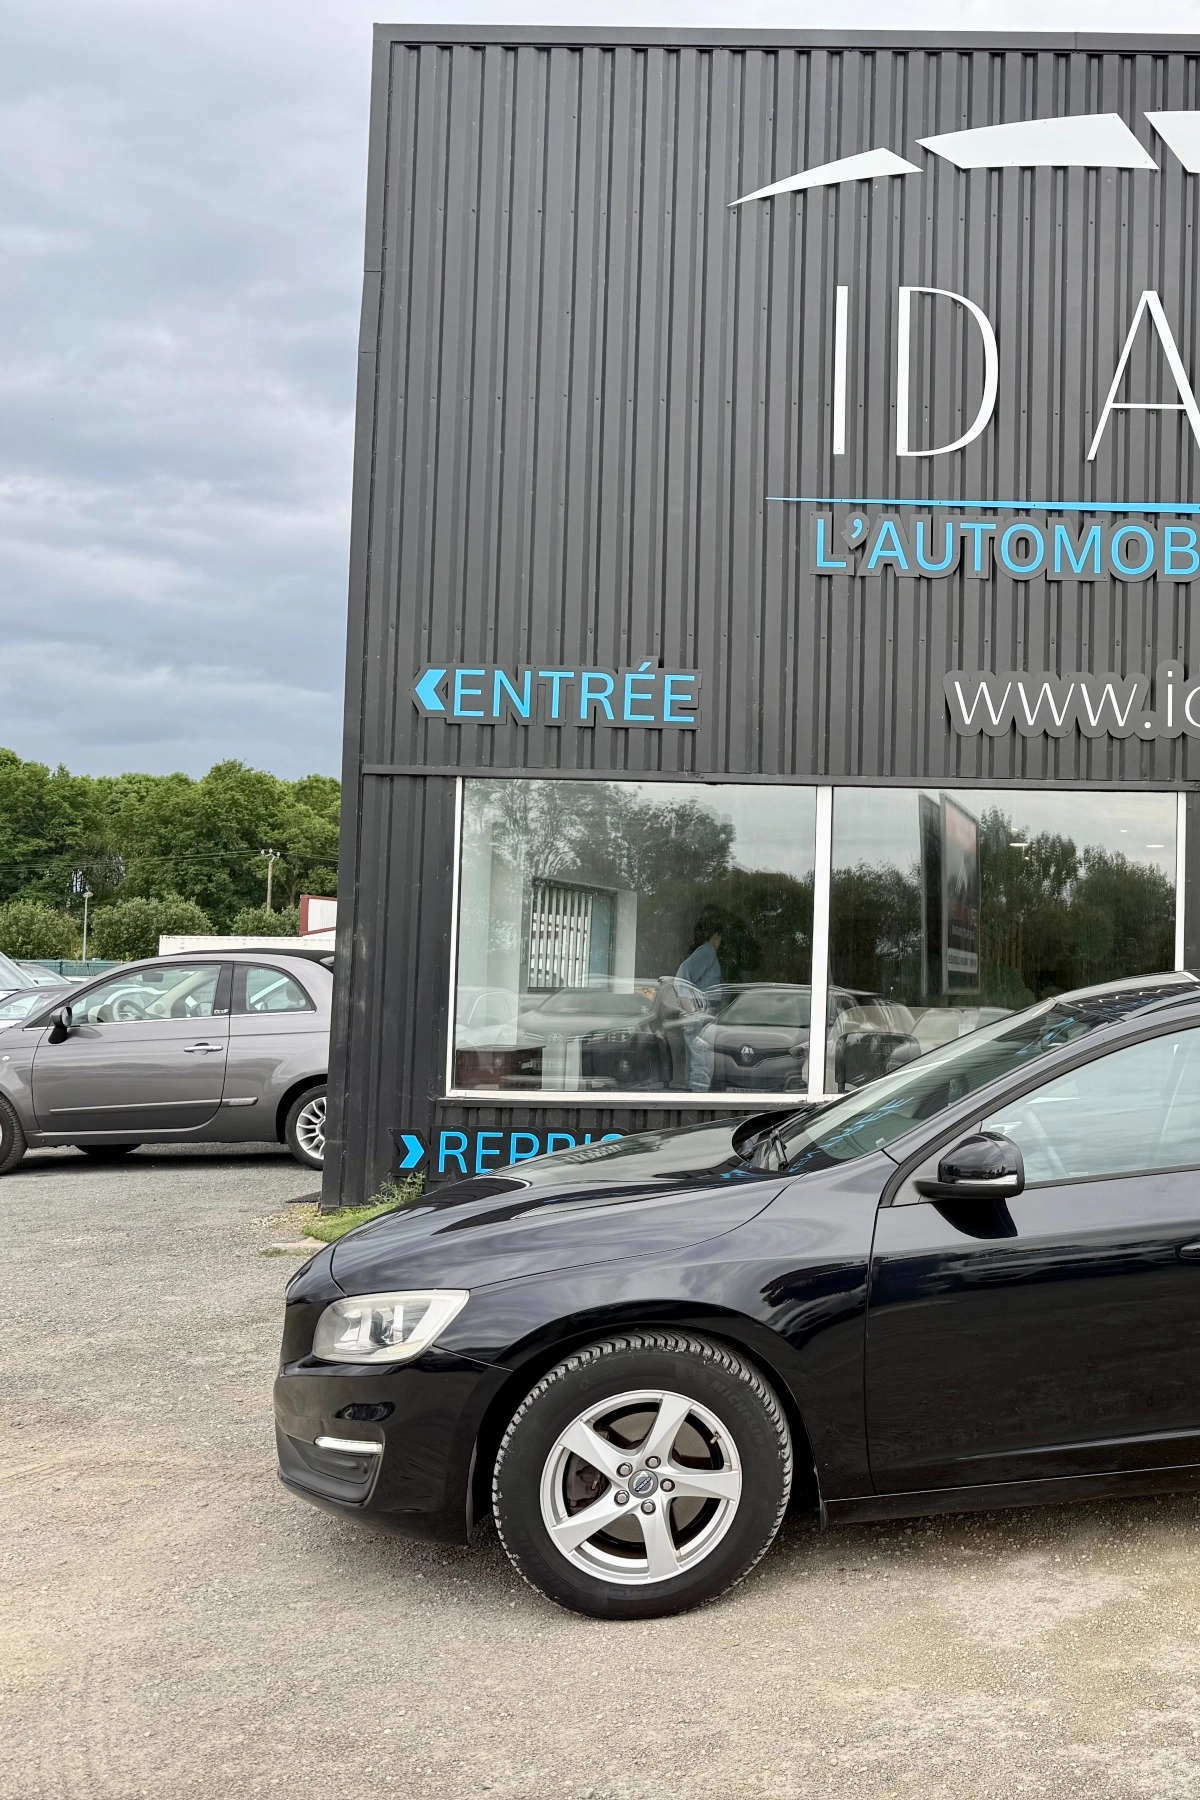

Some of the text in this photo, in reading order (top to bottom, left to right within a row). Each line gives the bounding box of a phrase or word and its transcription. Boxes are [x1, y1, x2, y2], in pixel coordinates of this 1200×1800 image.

[831, 285, 999, 458] ID
[453, 660, 695, 724] ENTRÉE
[438, 1130, 624, 1174] REP
